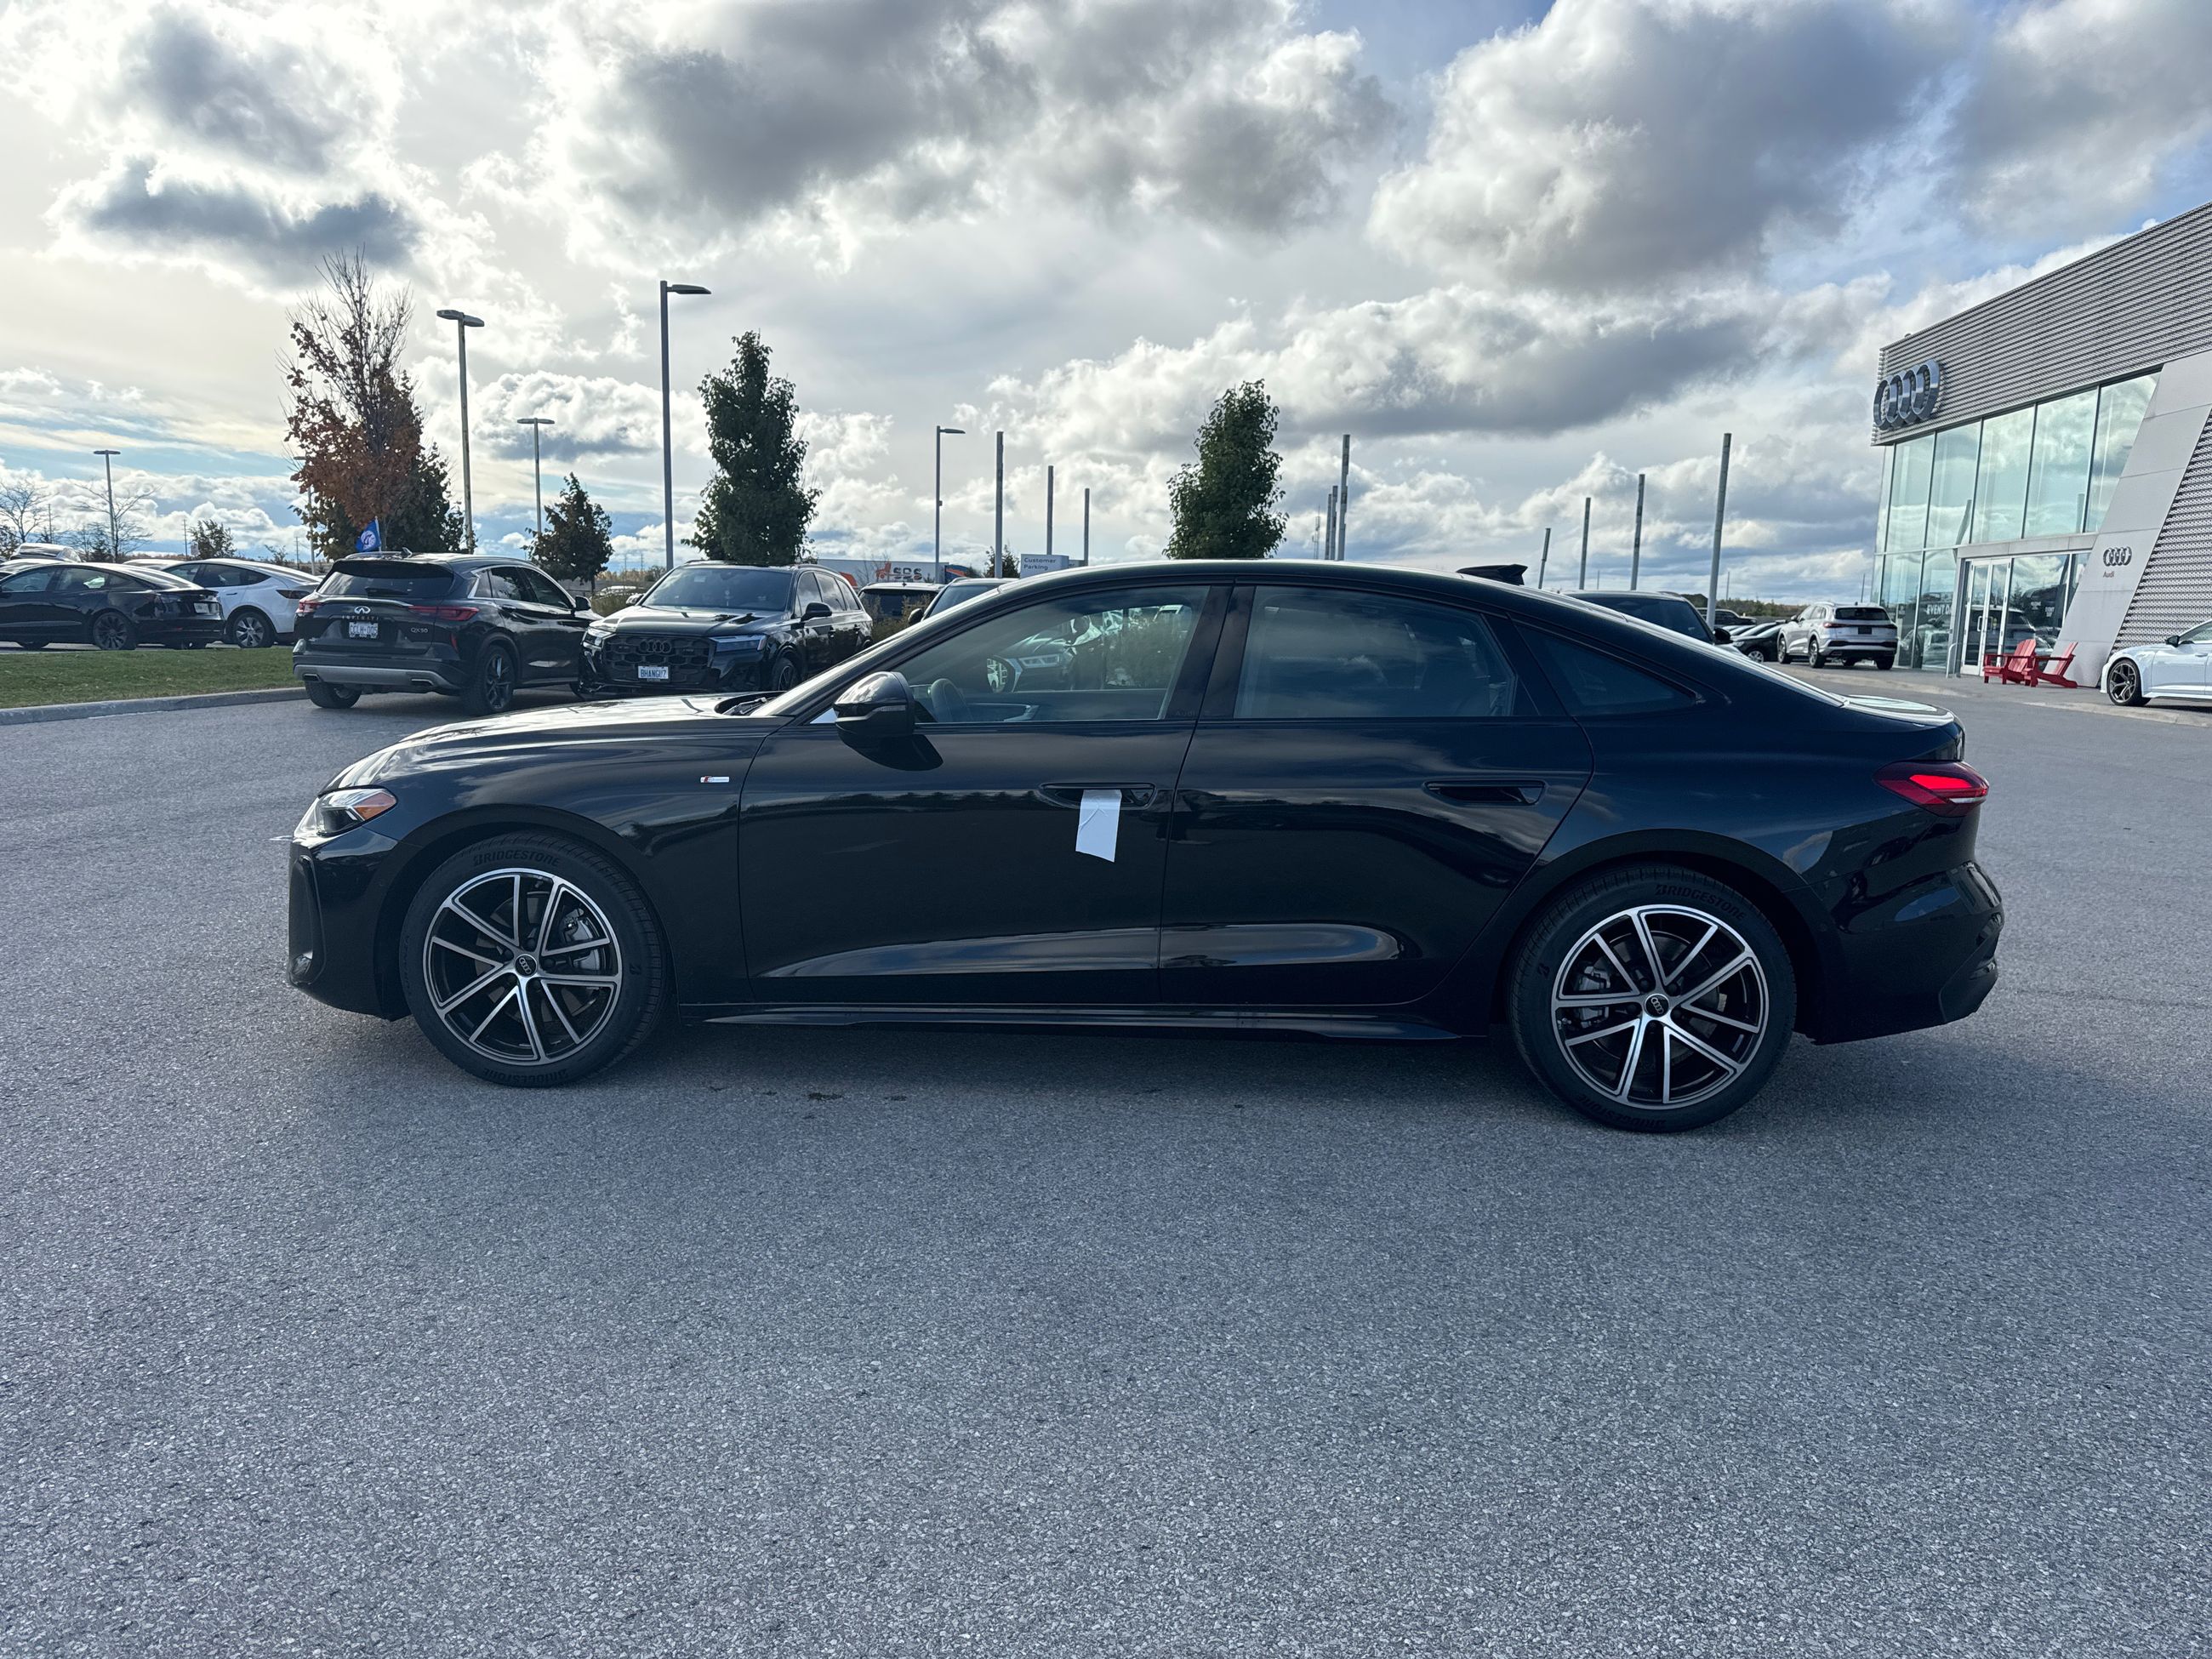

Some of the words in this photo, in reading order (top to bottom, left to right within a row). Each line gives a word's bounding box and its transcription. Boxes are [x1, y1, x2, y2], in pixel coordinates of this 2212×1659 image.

[1926, 604, 1945, 615] EVENT
[474, 850, 560, 867] BRIDGESTONE
[1655, 884, 1747, 920] BRIDGESTONE
